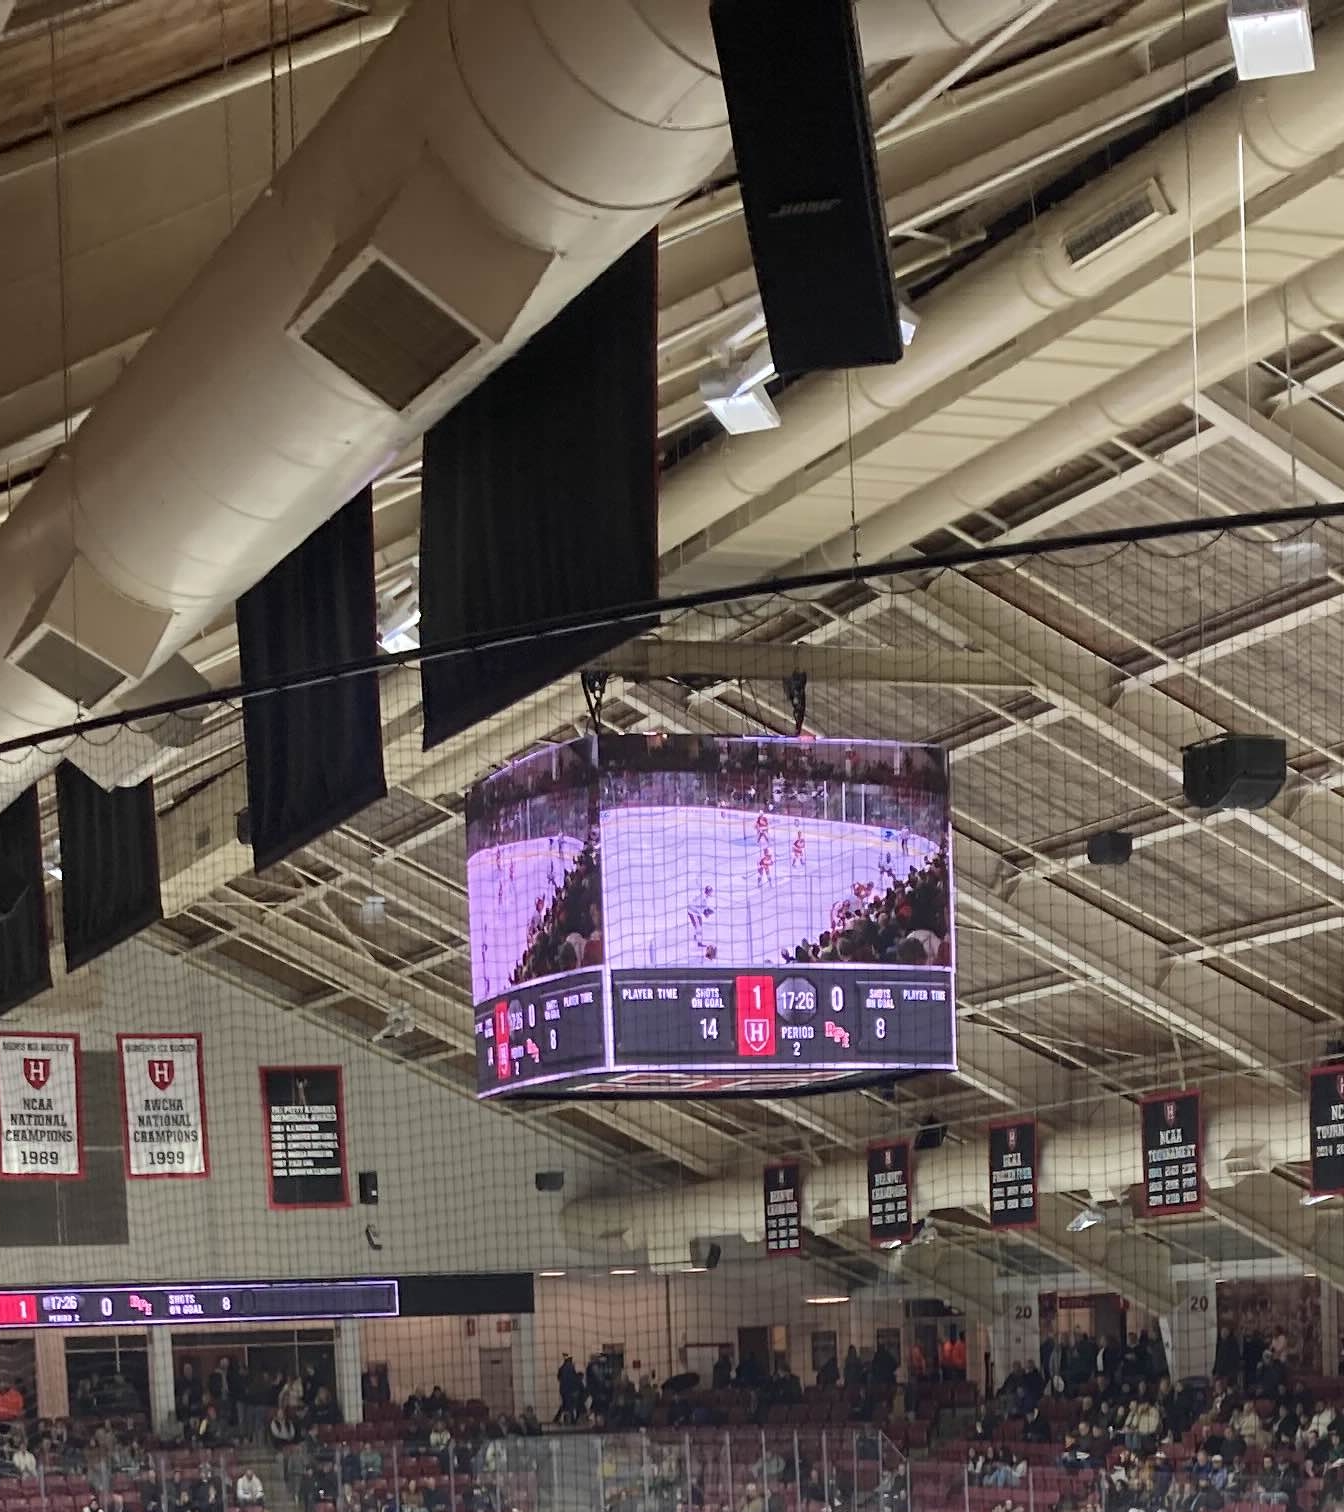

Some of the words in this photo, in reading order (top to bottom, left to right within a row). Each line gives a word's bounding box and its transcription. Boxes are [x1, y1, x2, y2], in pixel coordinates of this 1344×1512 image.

[622, 988, 653, 1000] PLAYER
[658, 988, 678, 999] TIME
[695, 988, 720, 998] SHOTS
[753, 984, 761, 1010] 1
[831, 985, 844, 1012] 0
[869, 988, 891, 999] SHOTS
[903, 989, 928, 1000] PLAYER
[931, 990, 946, 1001] TIME
[691, 999, 703, 1008] ON
[704, 998, 725, 1008] GOAL
[781, 991, 814, 1010] 17:26
[878, 998, 895, 1009] GOAL
[528, 1003, 535, 1028] 0
[700, 1018, 718, 1040] 14
[751, 1022, 764, 1042] H
[781, 1026, 814, 1039] PERIOD
[875, 1017, 886, 1039] 8
[550, 1029, 557, 1050] 8
[793, 1041, 801, 1056] 2
[29, 1061, 44, 1081] H
[154, 1062, 169, 1083] H
[23, 1098, 53, 1111] NCAA
[144, 1099, 184, 1111] AWCHA
[10, 1114, 67, 1127] NATIONAL
[138, 1114, 191, 1127] NATIONAL
[6, 1130, 73, 1142] CHAMPIONS
[134, 1130, 198, 1143] CHAMPIONS
[1160, 1128, 1182, 1145] NCAA
[21, 1151, 59, 1165] 1989
[149, 1151, 185, 1165] 1999
[1148, 1144, 1196, 1163] TOURNAMENT
[50, 1296, 77, 1310] 17:26
[101, 1297, 113, 1316] 0
[168, 1295, 196, 1304] SHOTS
[222, 1296, 231, 1311] 8
[1191, 1296, 1208, 1312] 20
[19, 1301, 27, 1318] 1
[183, 1304, 204, 1315] GOAL
[1016, 1306, 1032, 1320] 20
